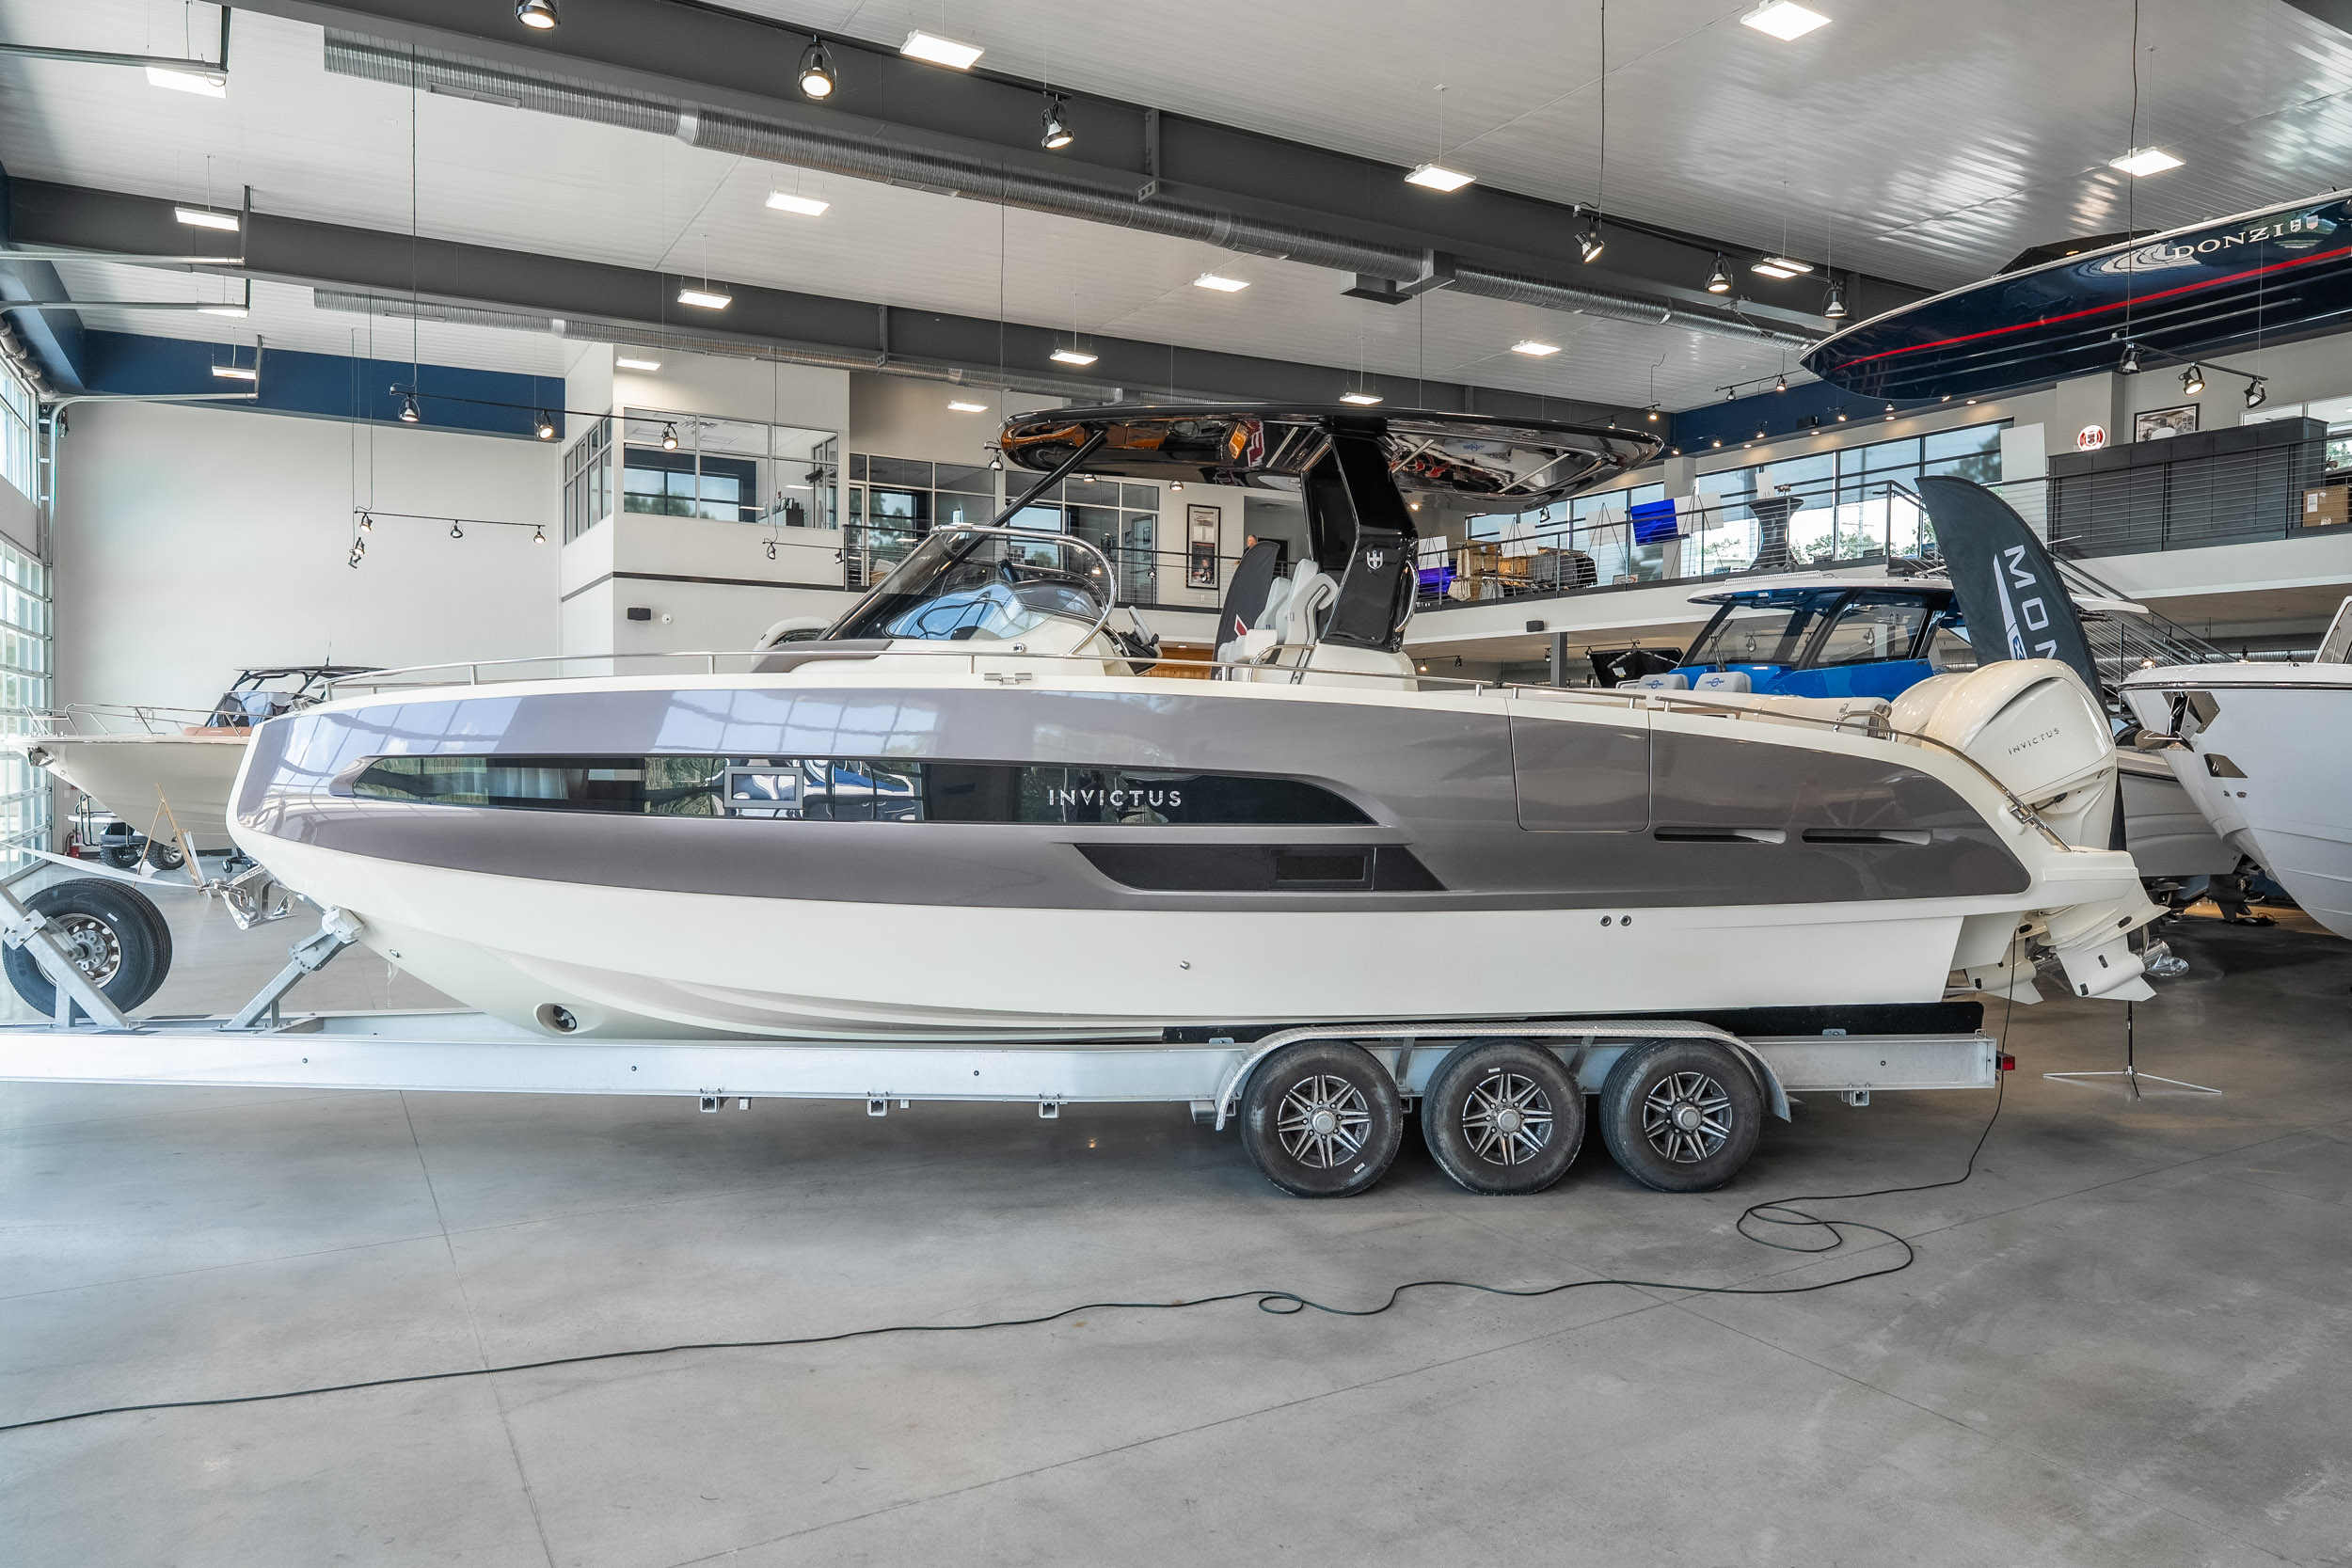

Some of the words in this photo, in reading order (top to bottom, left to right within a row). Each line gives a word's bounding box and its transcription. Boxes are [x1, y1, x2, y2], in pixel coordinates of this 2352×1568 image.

[2171, 223, 2284, 260] DONZI
[2008, 727, 2060, 755] INVICTUS
[1048, 789, 1182, 807] INVICTUS
